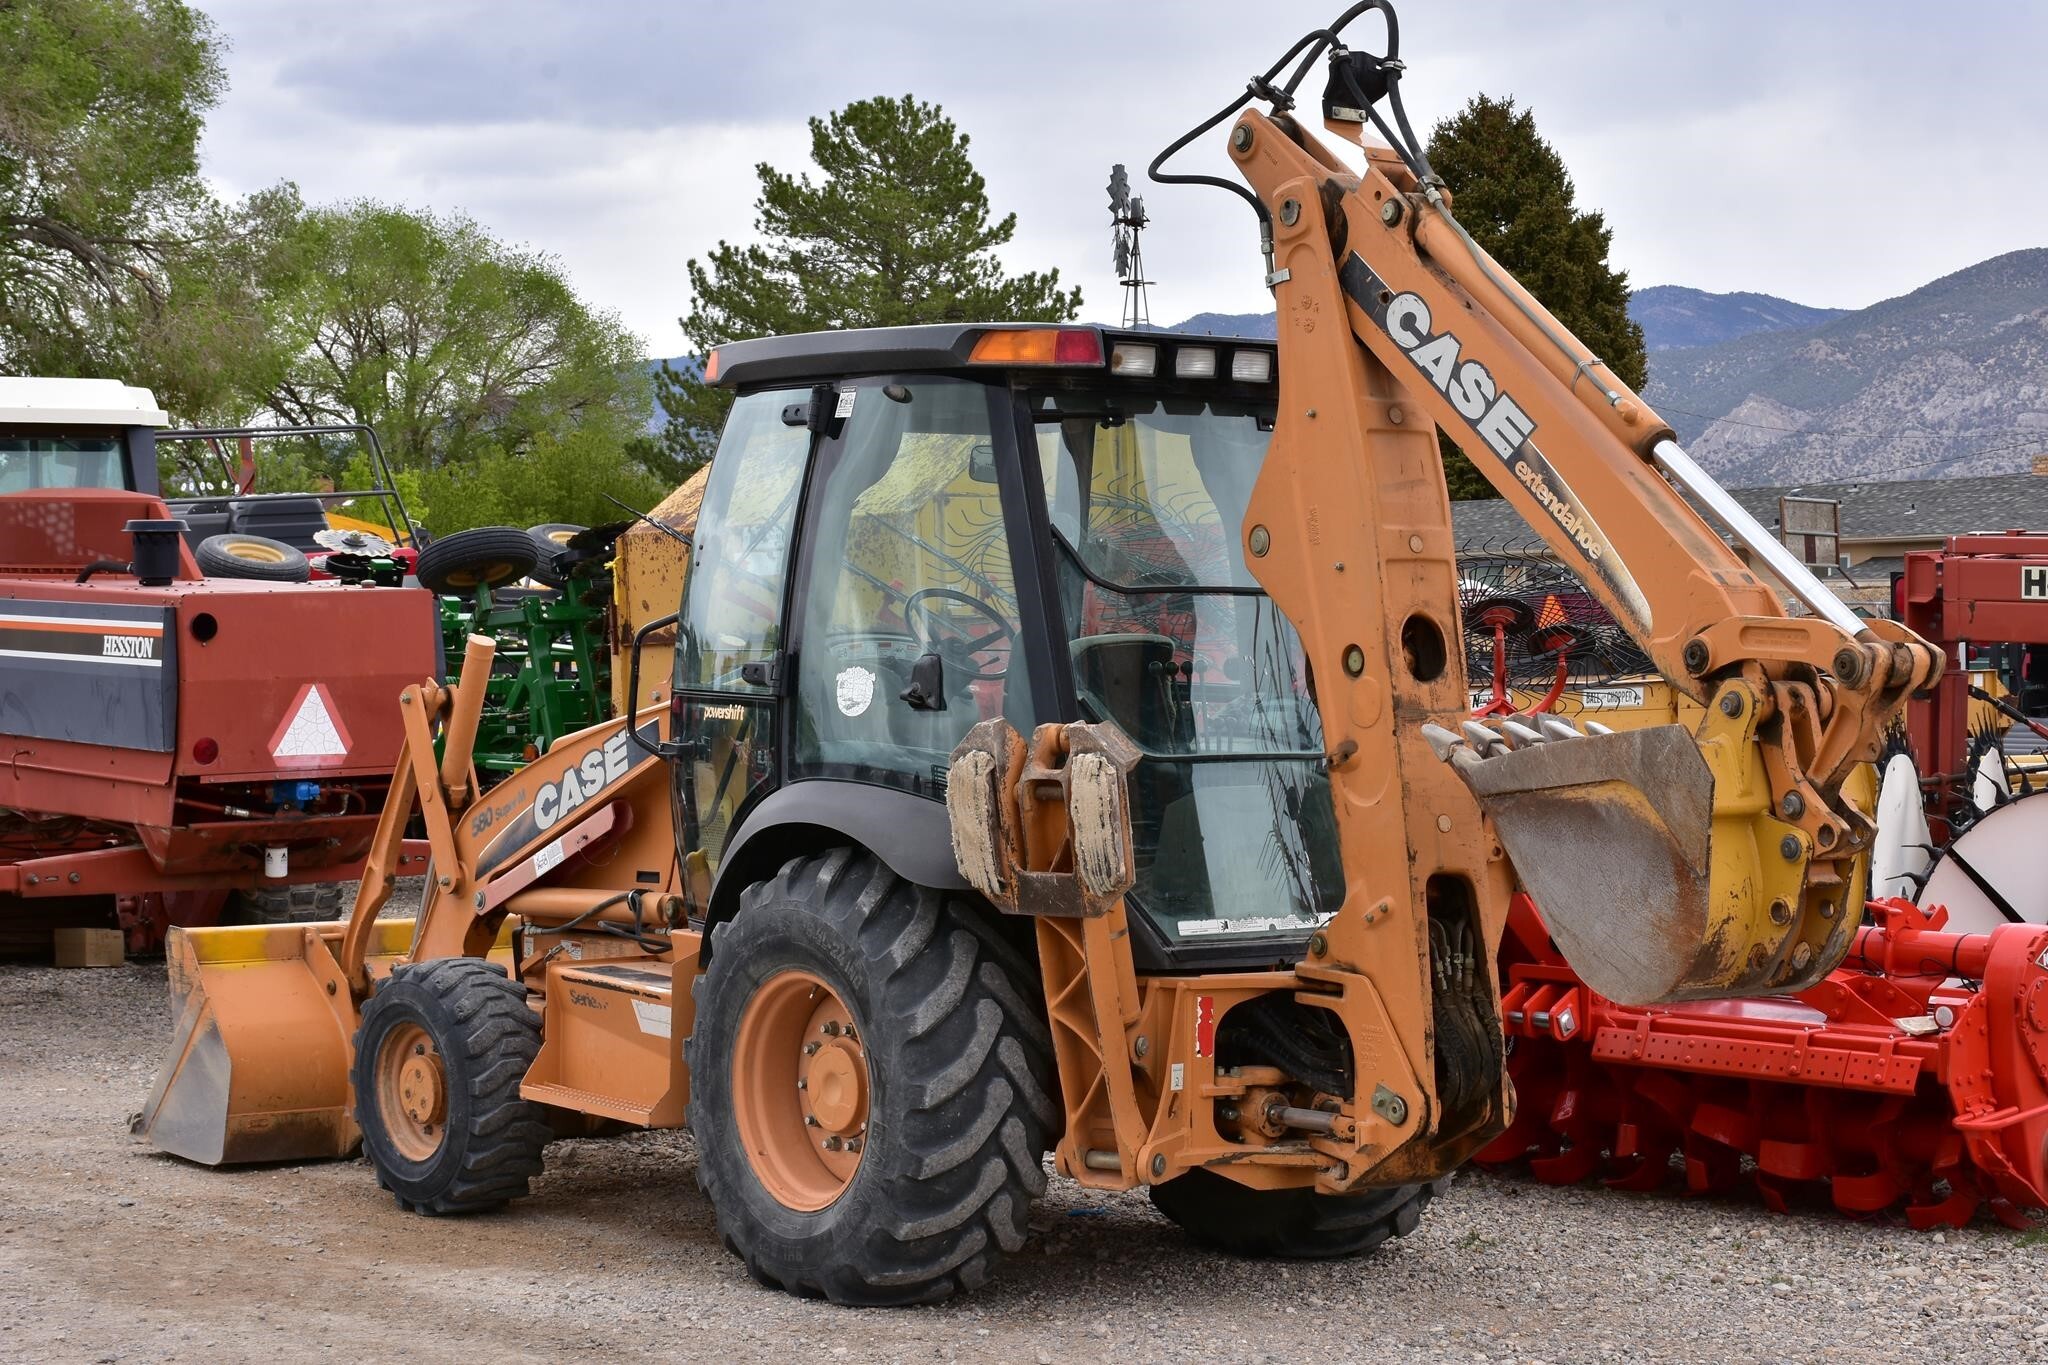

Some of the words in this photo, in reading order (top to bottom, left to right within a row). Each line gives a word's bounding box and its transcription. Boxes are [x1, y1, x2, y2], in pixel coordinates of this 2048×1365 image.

[1385, 293, 1536, 460] CASE
[1514, 461, 1602, 560] extendahoe
[102, 635, 154, 658] HESSTON
[703, 703, 745, 720] powershift
[533, 732, 630, 830] CASE
[472, 806, 494, 838] 580
